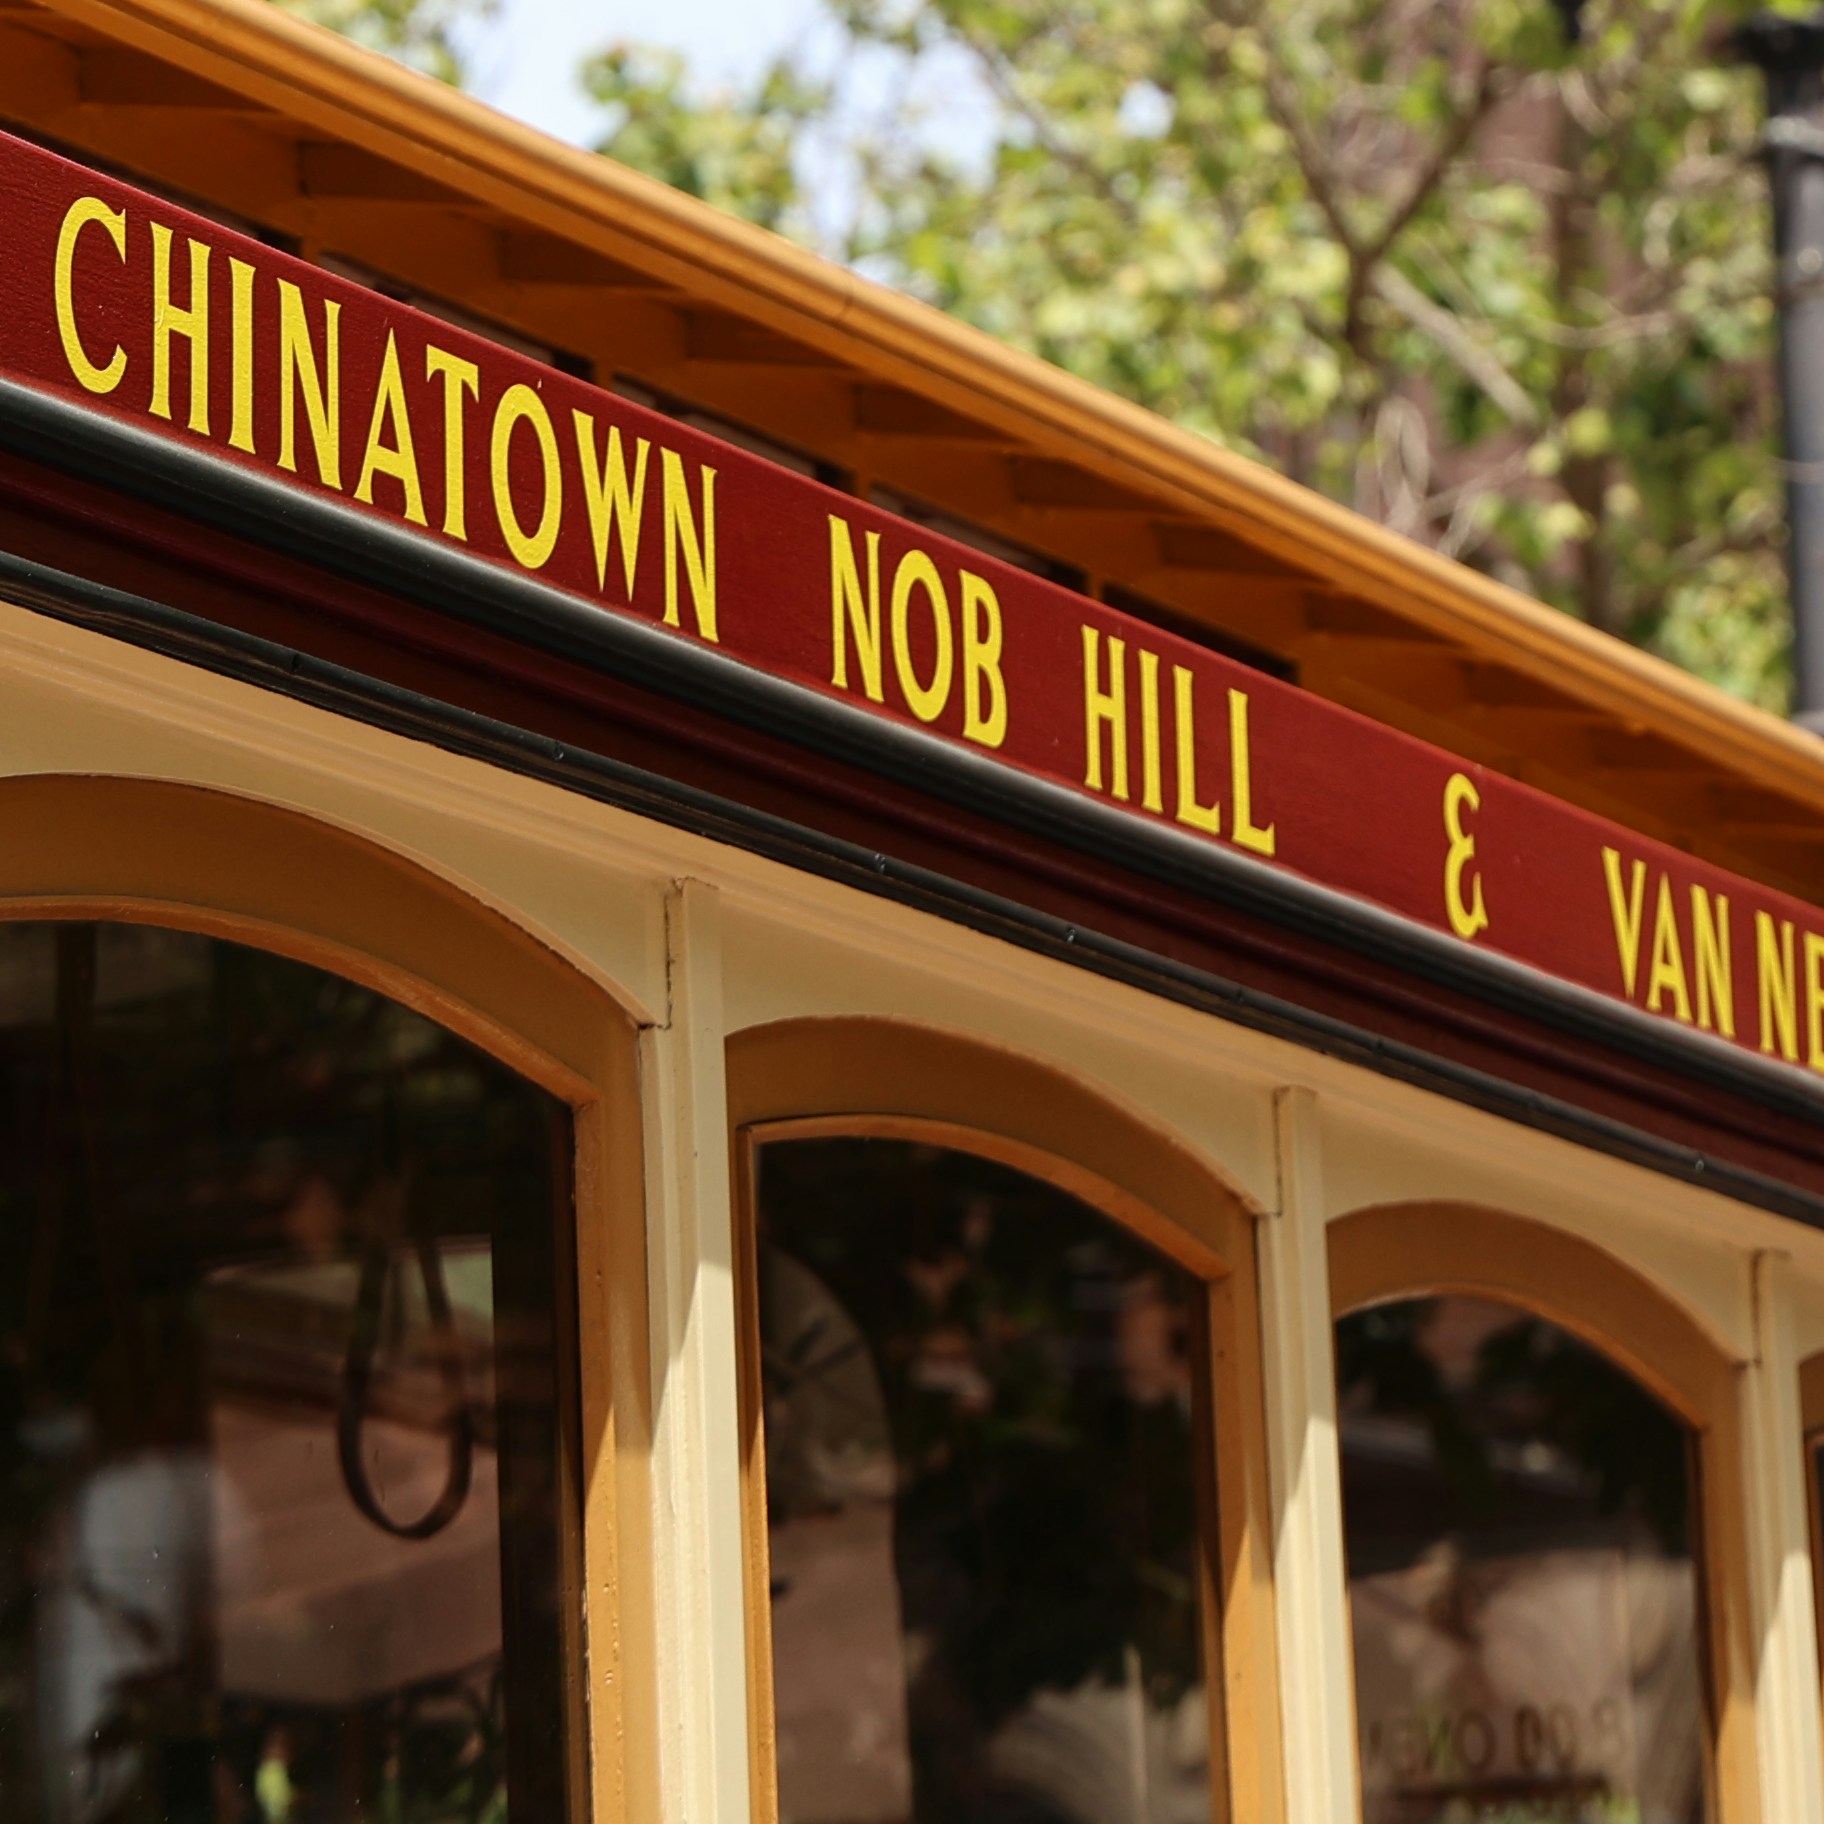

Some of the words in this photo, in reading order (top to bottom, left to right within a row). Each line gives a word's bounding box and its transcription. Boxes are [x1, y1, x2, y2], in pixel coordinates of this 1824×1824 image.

[54, 197, 719, 643] CHINATOWN
[827, 514, 1008, 749] NOB
[1081, 624, 1276, 856] HILL
[1443, 772, 1488, 939] &
[1601, 845, 1735, 1038] VAN
